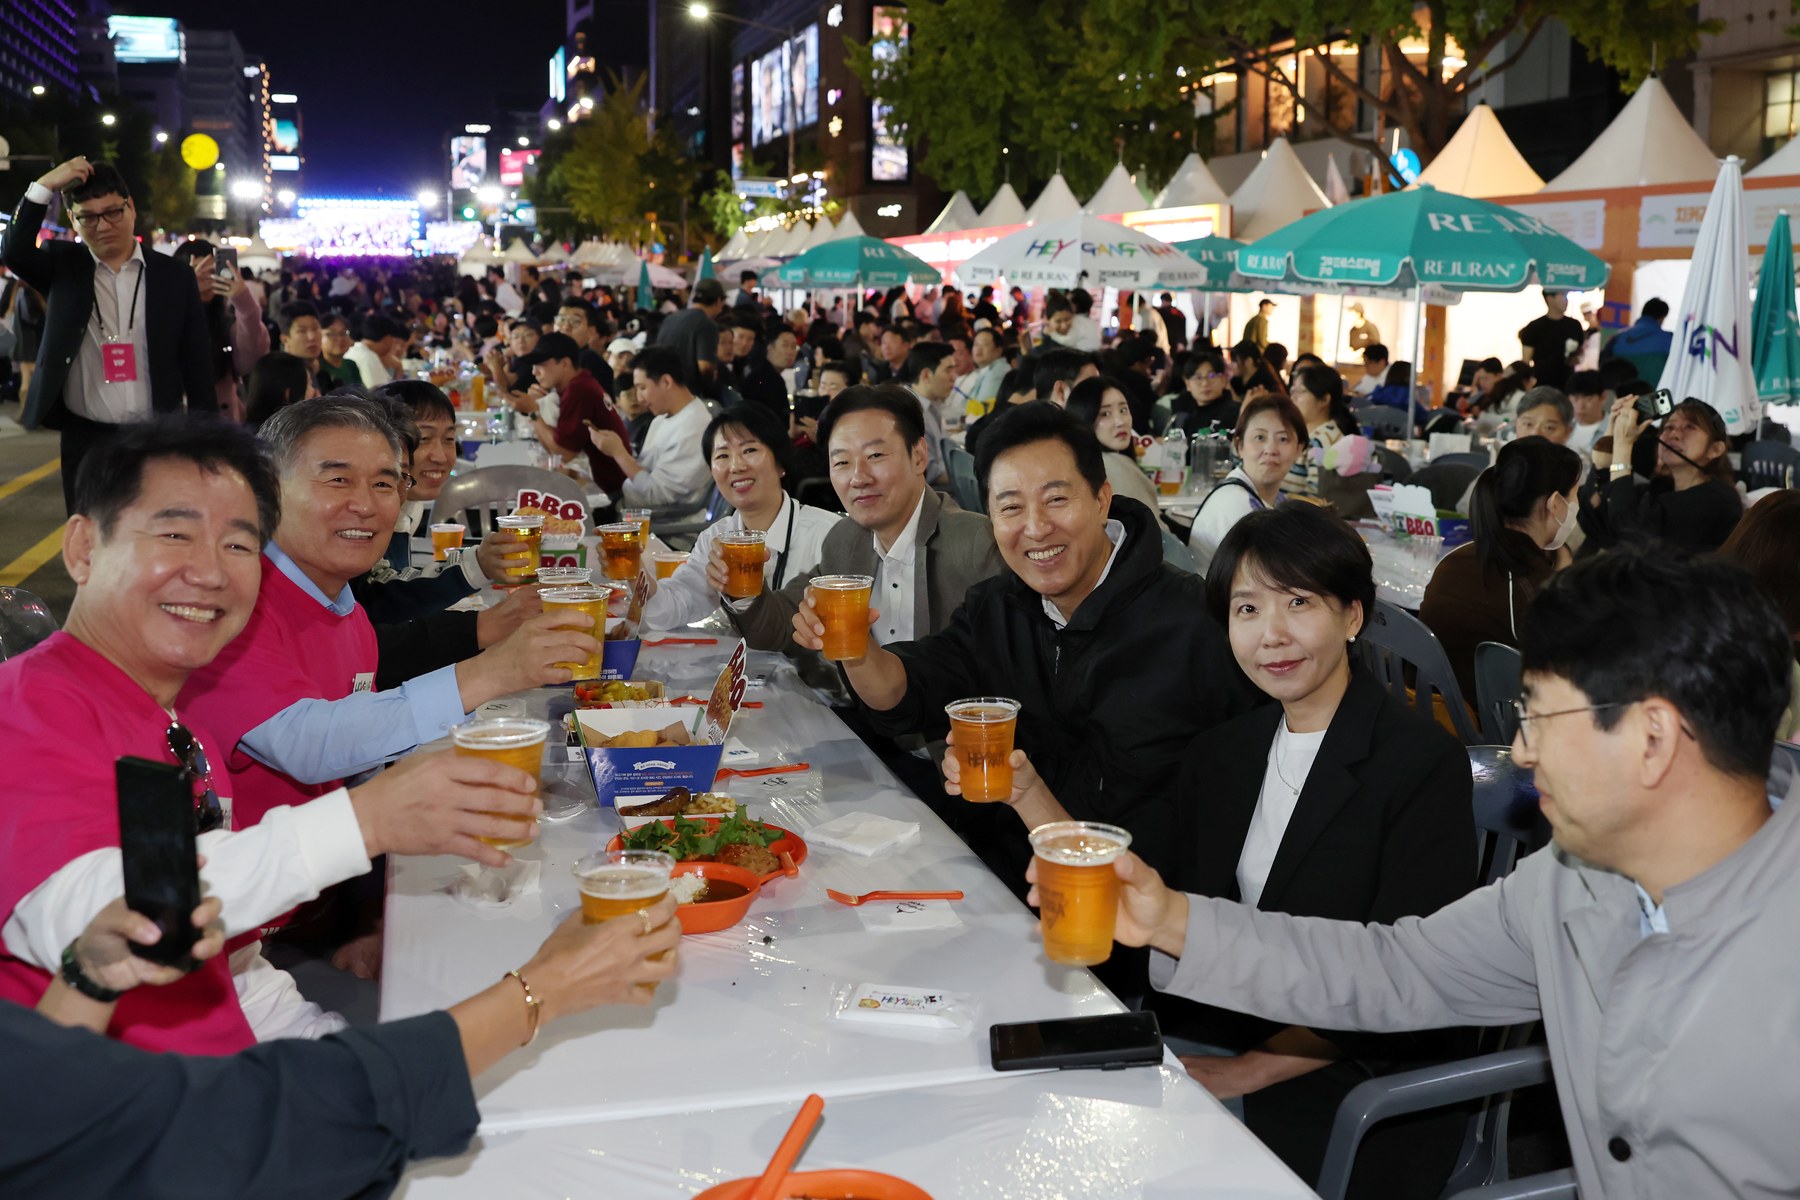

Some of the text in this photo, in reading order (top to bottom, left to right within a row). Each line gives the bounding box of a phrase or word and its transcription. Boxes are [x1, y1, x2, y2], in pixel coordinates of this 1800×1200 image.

[1025, 240, 1077, 263] HEY
[1424, 259, 1510, 278] REJURAN
[520, 491, 585, 521] BBQ
[1406, 516, 1435, 537] BBQ
[728, 642, 747, 712] BBQ
